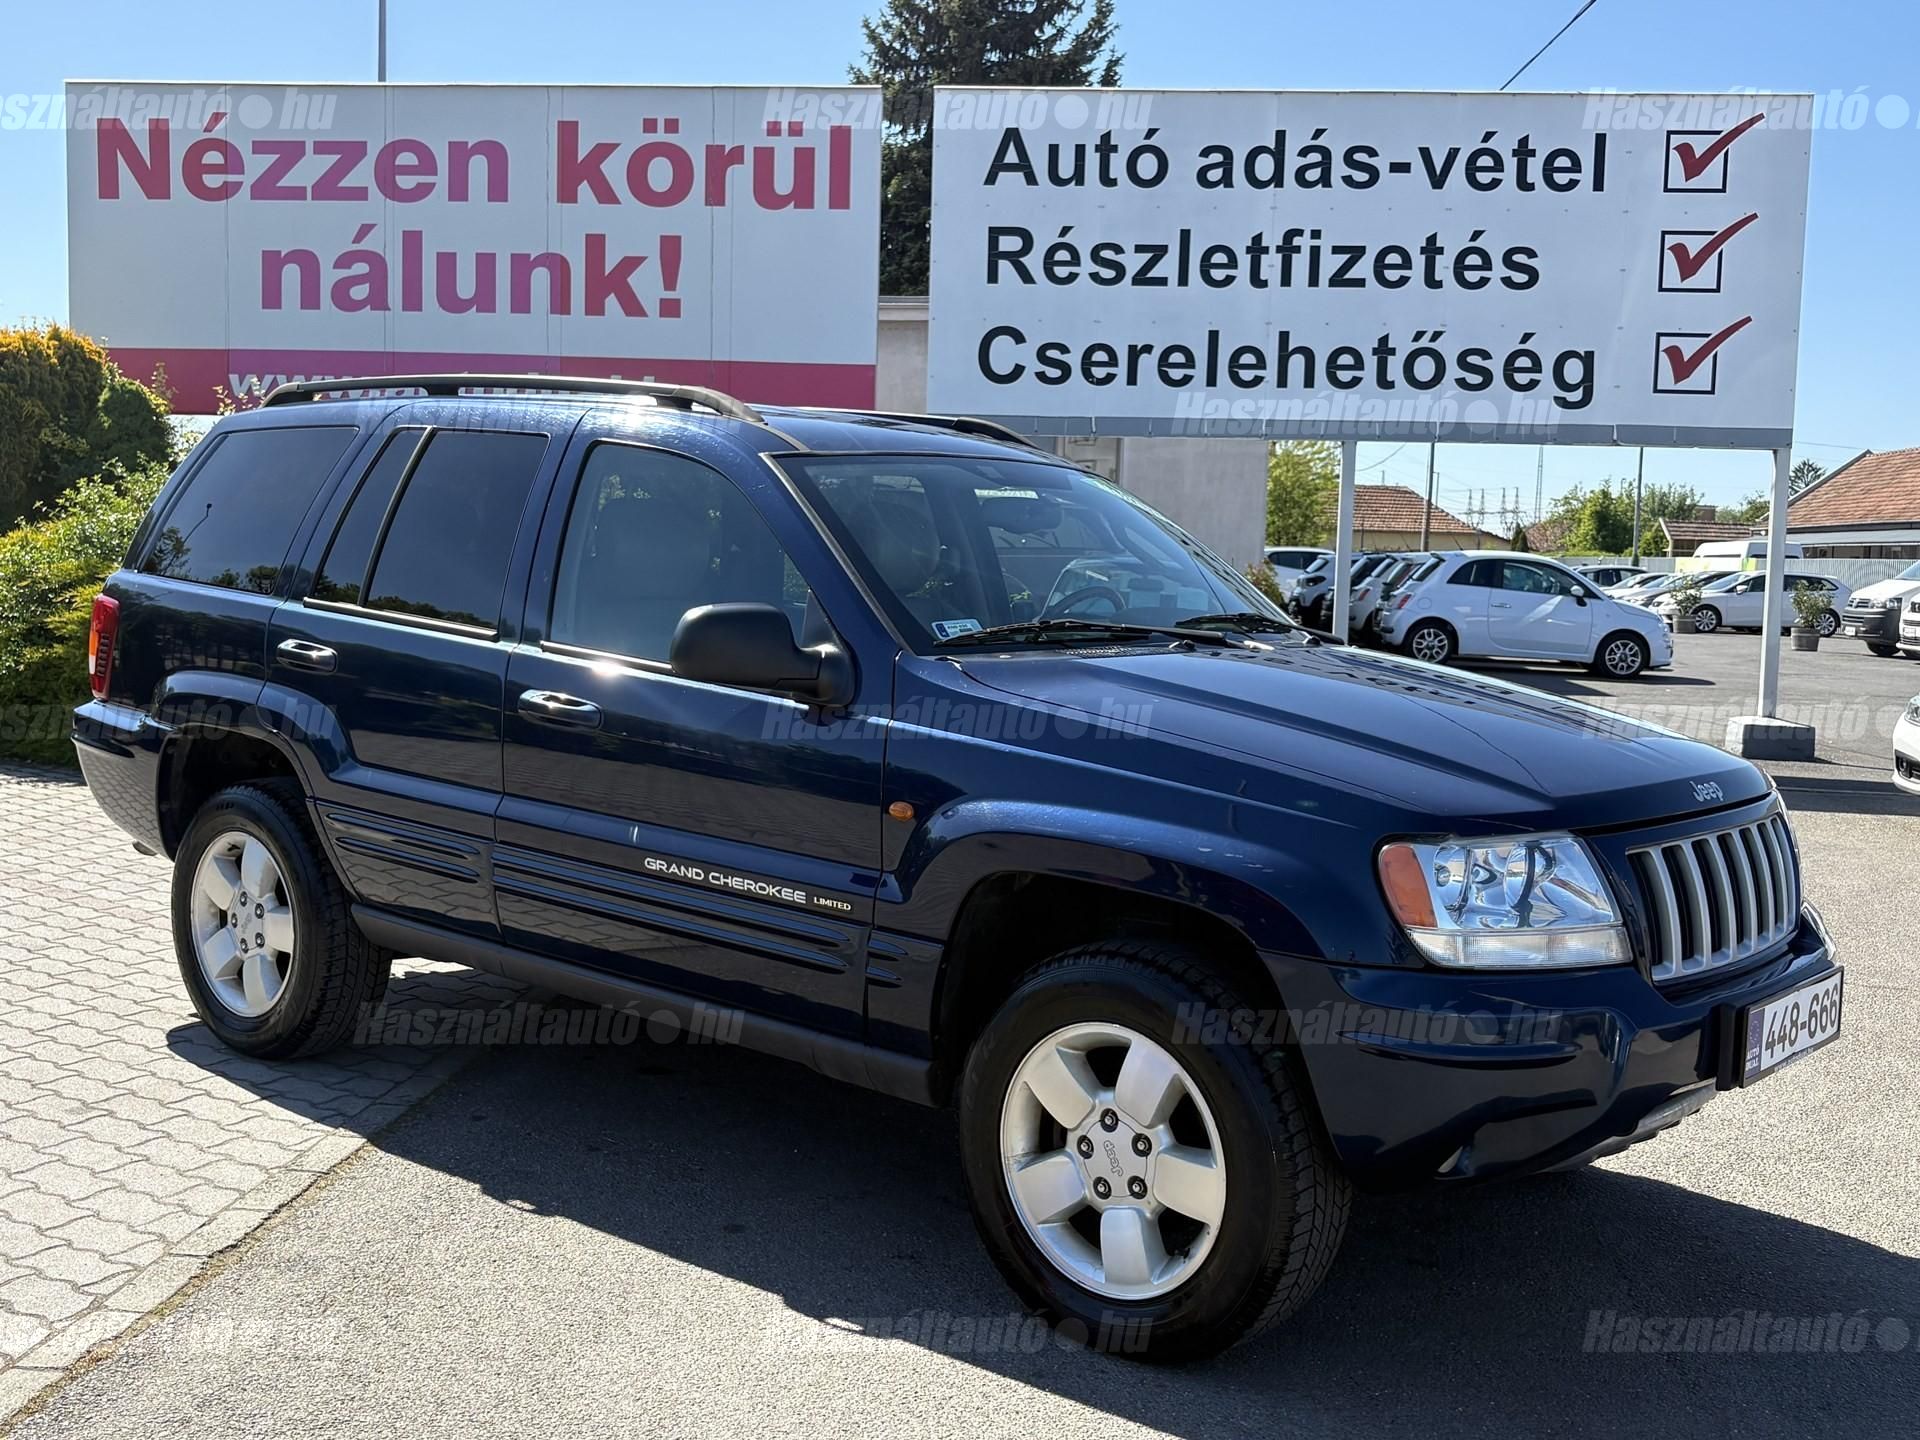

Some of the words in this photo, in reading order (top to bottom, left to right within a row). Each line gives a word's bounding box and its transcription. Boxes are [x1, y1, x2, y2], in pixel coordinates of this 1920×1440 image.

[97, 112, 509, 204] Nézzen
[556, 117, 852, 211] körül
[983, 127, 1170, 189] Autó
[1196, 127, 1608, 194] adás-vétel
[261, 223, 683, 319] nálunk!
[985, 225, 1541, 291] Részletfizetés
[976, 324, 1597, 409] Cserelehetőség
[1689, 780, 1724, 802] Jeep
[643, 857, 705, 881] GRAND
[708, 871, 807, 904] CHEROKEE
[813, 896, 852, 911] LIMITED
[1764, 983, 1839, 1059] 448-666
